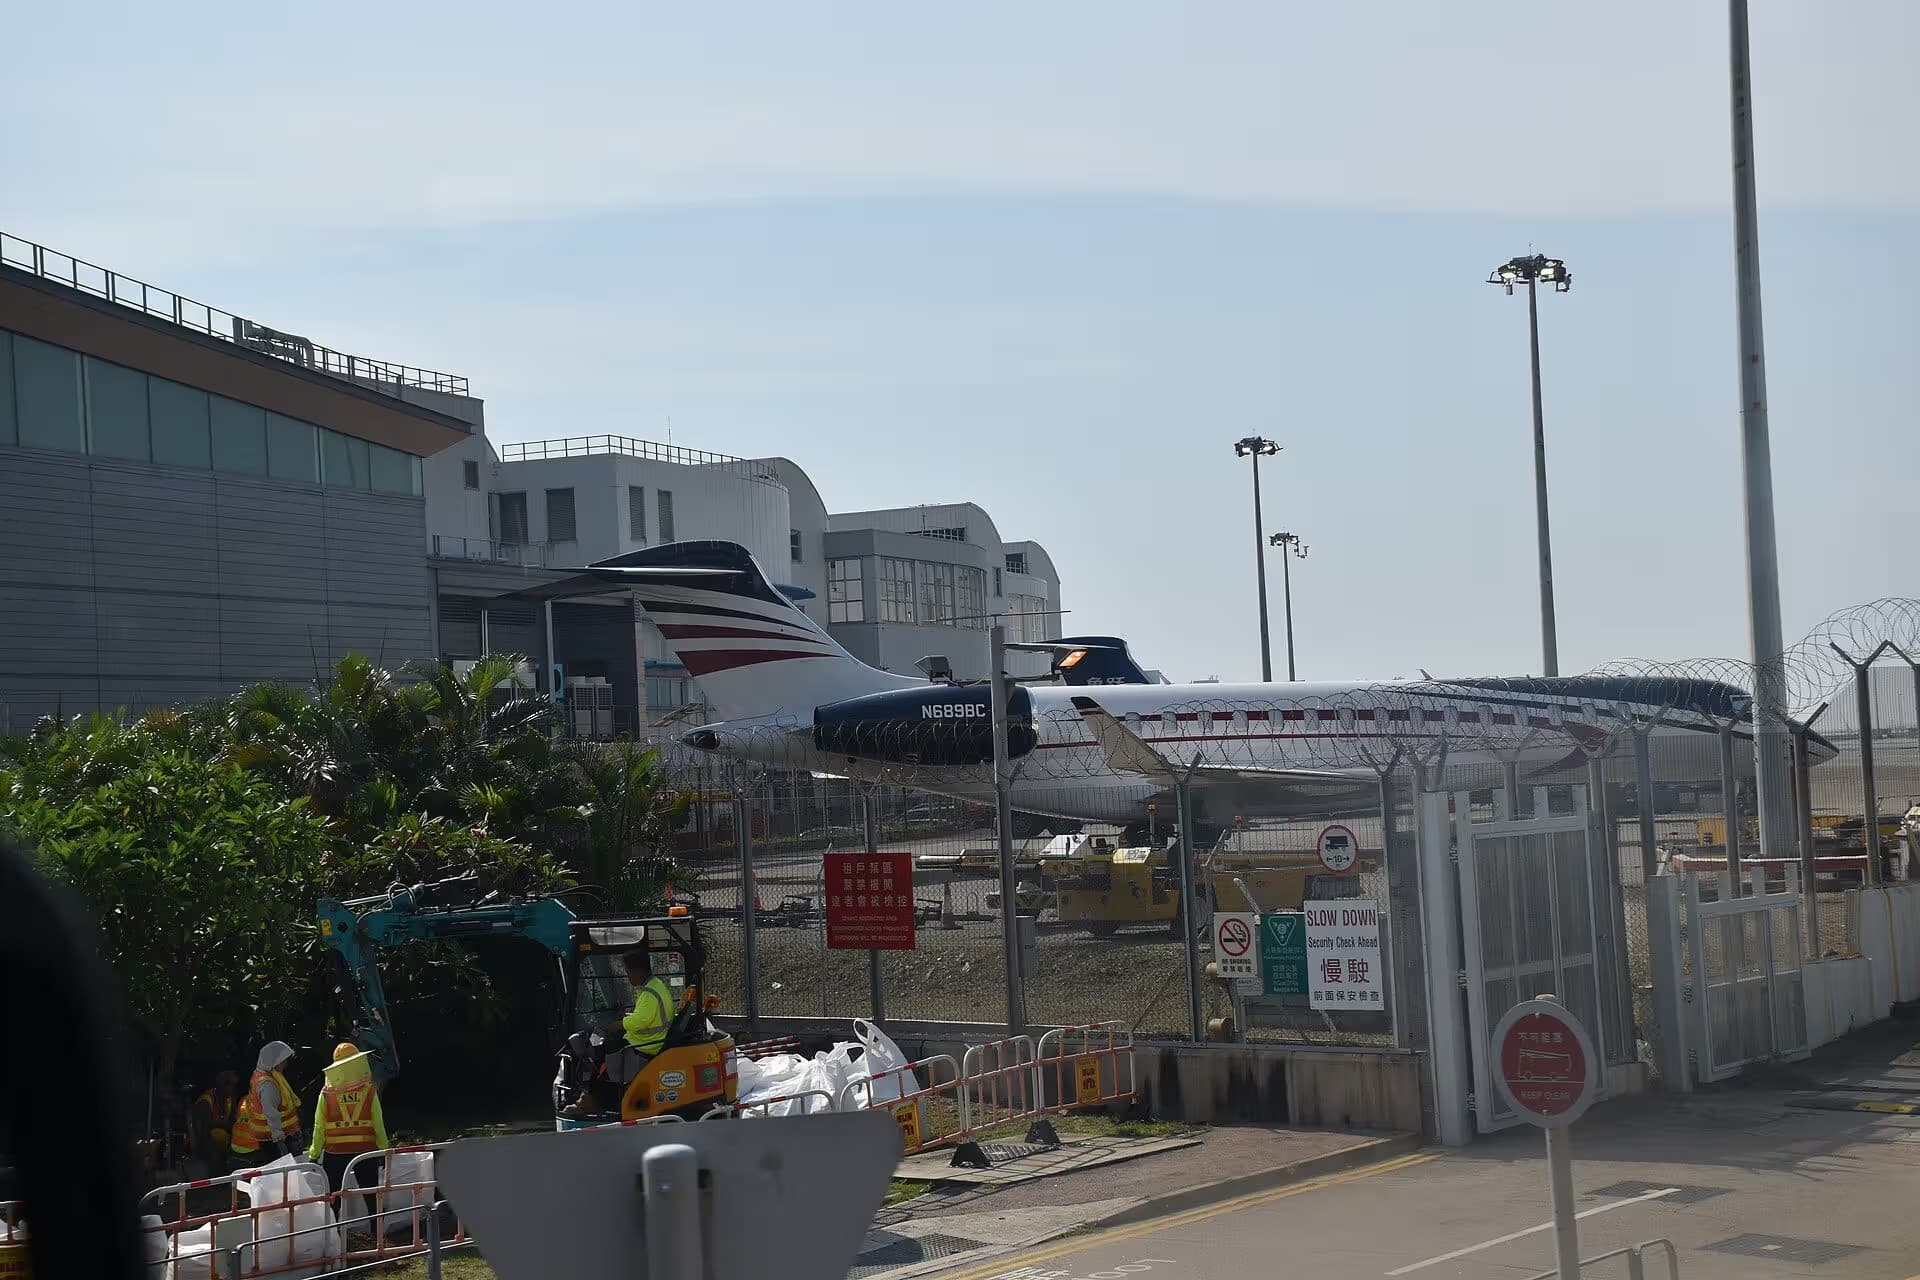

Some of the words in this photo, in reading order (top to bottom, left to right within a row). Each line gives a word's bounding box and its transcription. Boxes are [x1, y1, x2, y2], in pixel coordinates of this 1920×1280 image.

[922, 704, 986, 719] N689BC
[1307, 910, 1337, 927] SLOW
[1343, 909, 1377, 926] DOWN
[1308, 936, 1334, 950] Security
[1336, 936, 1356, 948] Check
[1358, 936, 1378, 948] Ahead
[1320, 958, 1370, 983] 慢駛
[1313, 991, 1380, 1002] 前面保安檢查
[342, 1092, 361, 1103] ASL
